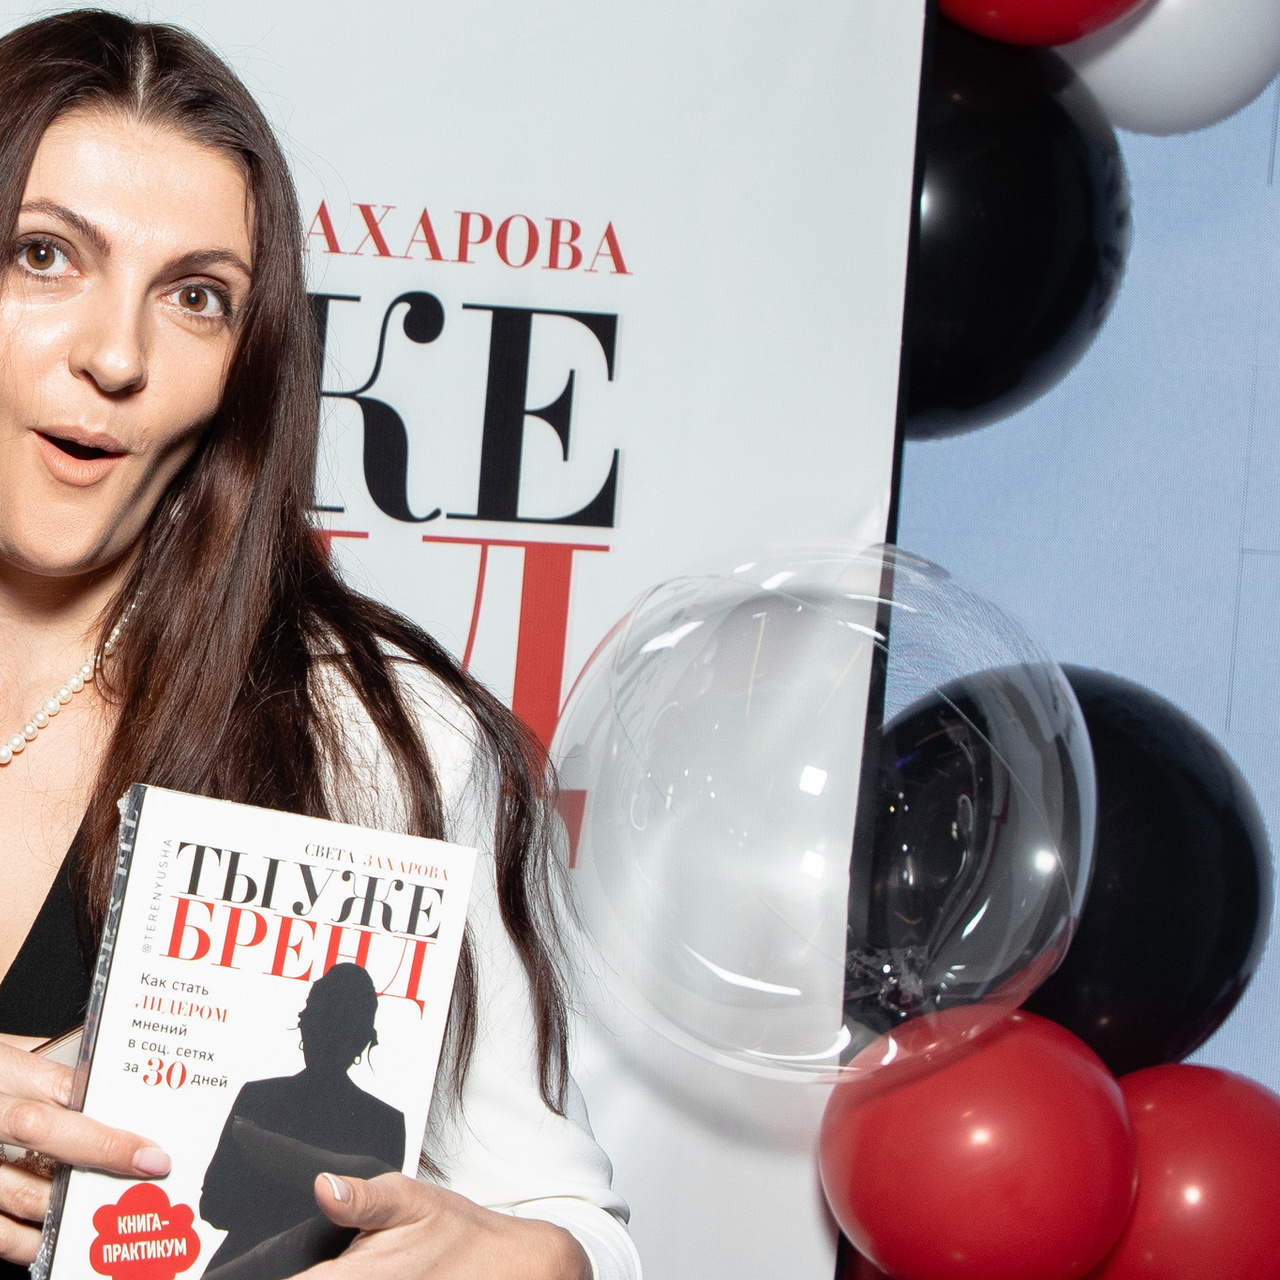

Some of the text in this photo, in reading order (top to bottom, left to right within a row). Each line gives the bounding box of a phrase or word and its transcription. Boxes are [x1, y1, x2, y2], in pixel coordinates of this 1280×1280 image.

[302, 198, 634, 276] АХАРОВА
[305, 842, 450, 882] СВЕТА ЗАХАРОВА
[141, 838, 174, 954] @TERENYUSHA
[176, 841, 445, 940] ТЫ УЖЕ
[158, 895, 437, 1020] БРЕНД
[140, 972, 210, 996] Как стать
[135, 994, 228, 1023] ЛИДЕРОМ
[131, 1019, 188, 1037] мнений
[128, 1038, 215, 1062] в соц. сетях
[123, 1056, 228, 1090] за 30 дней
[117, 1212, 170, 1235] КНИГА-
[103, 1237, 187, 1263] ПРАКТИКУМ
